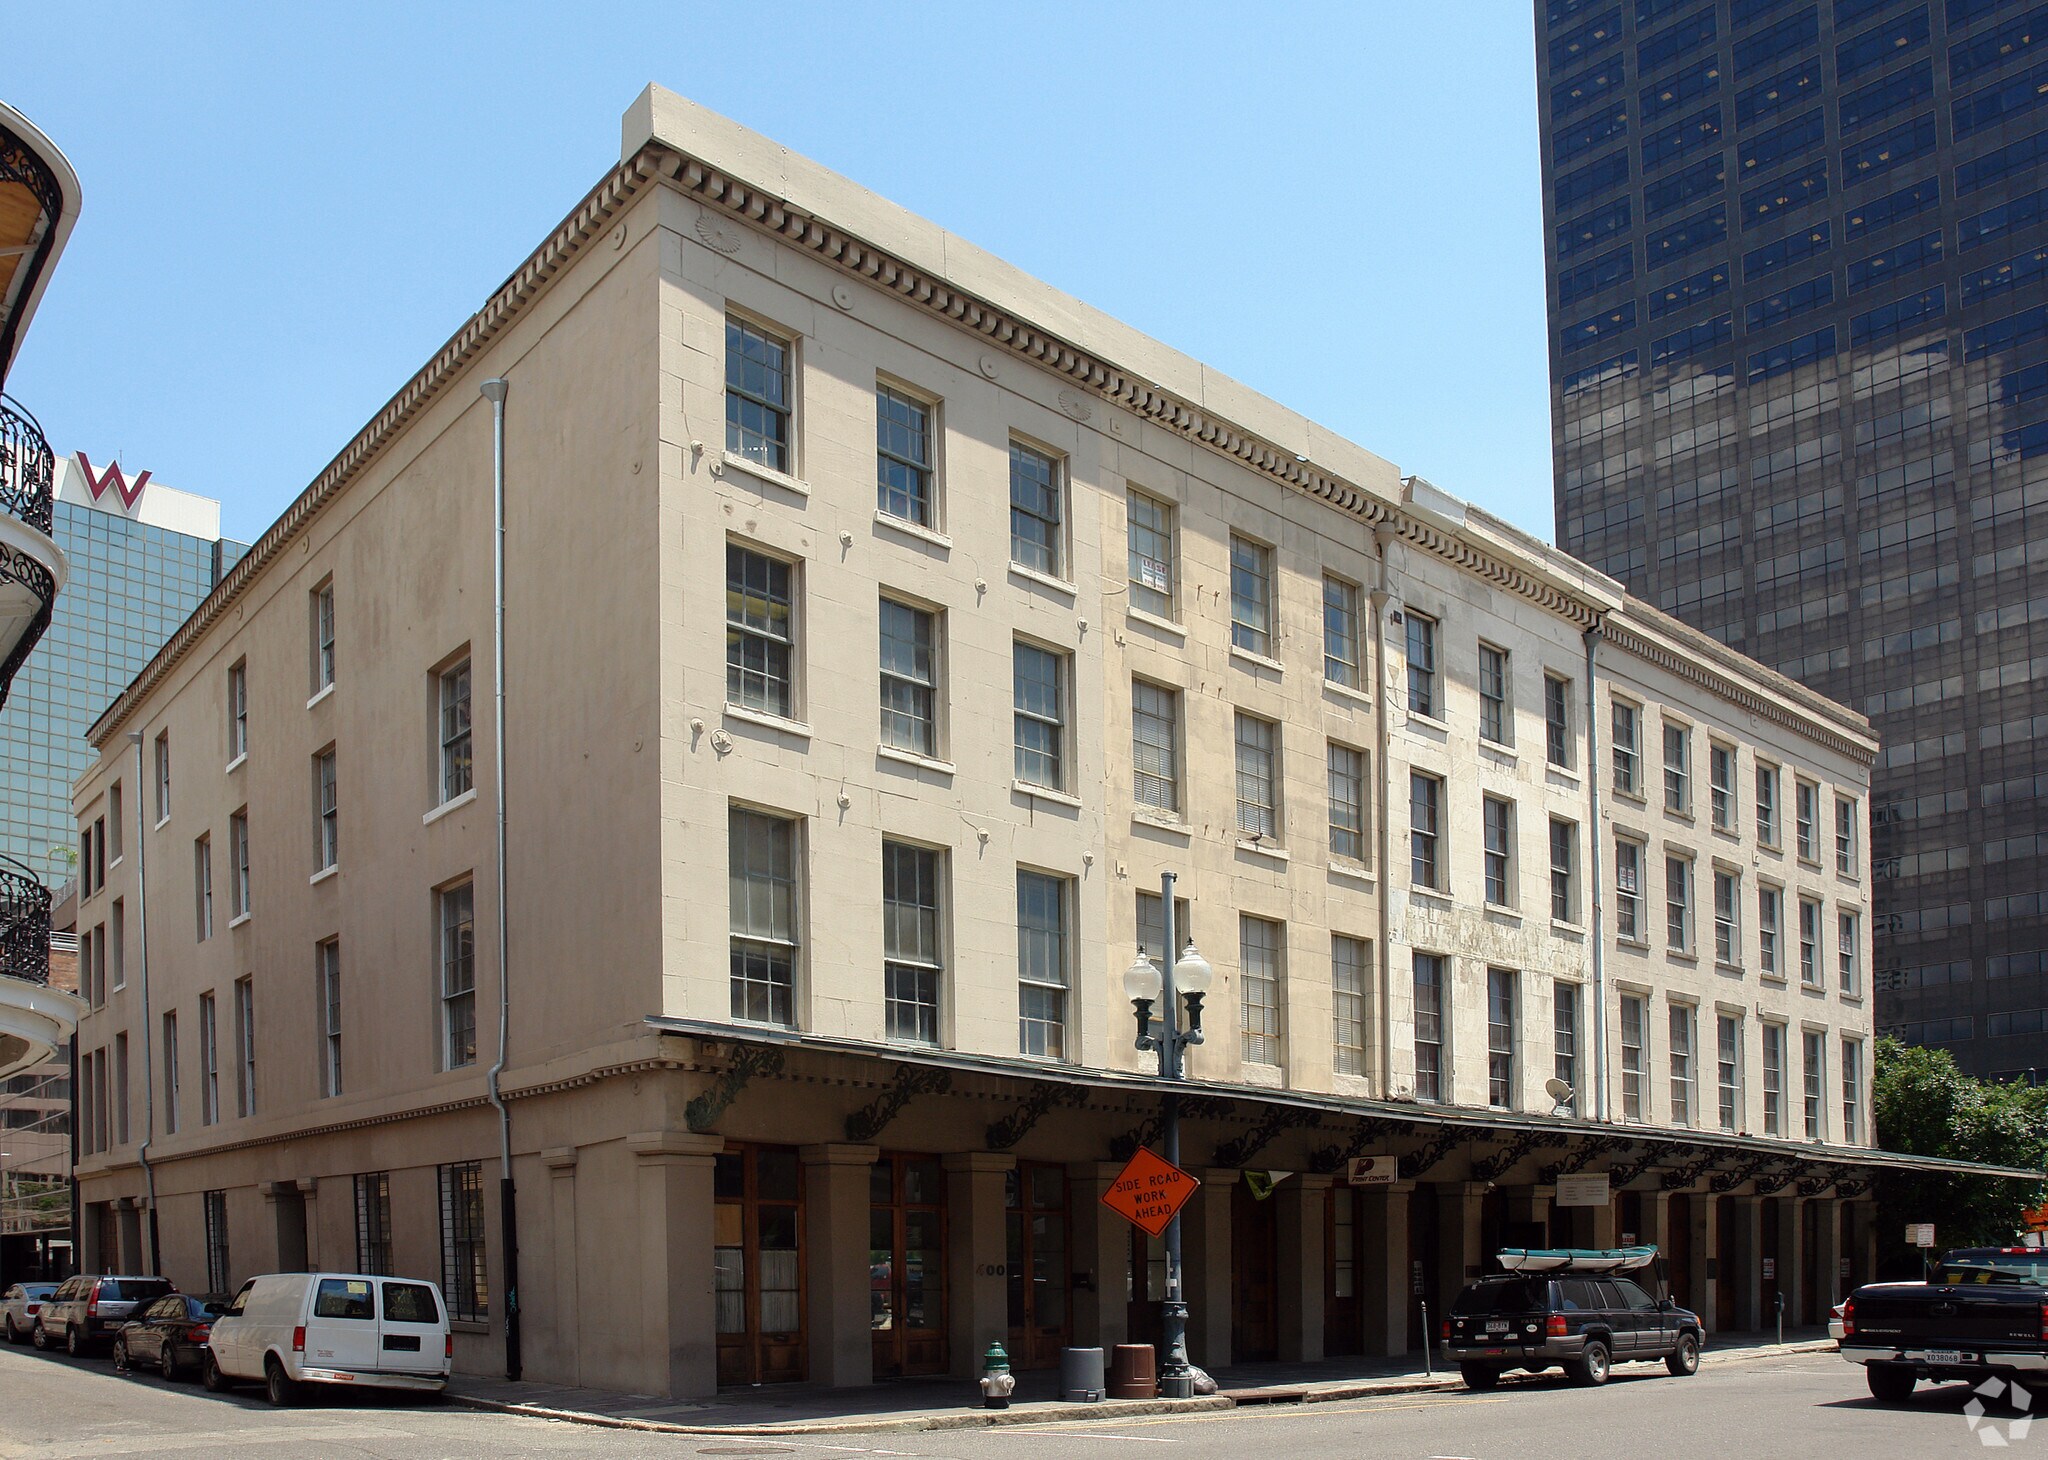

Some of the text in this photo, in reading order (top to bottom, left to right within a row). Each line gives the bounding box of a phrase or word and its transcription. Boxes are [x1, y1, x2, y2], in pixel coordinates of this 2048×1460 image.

[76, 450, 153, 511] W
[1143, 559, 1166, 575] LEASE
[1116, 1171, 1180, 1193] SIDE ROAD
[1134, 1189, 1166, 1204] WORK
[1135, 1204, 1171, 1219] AHEAD
